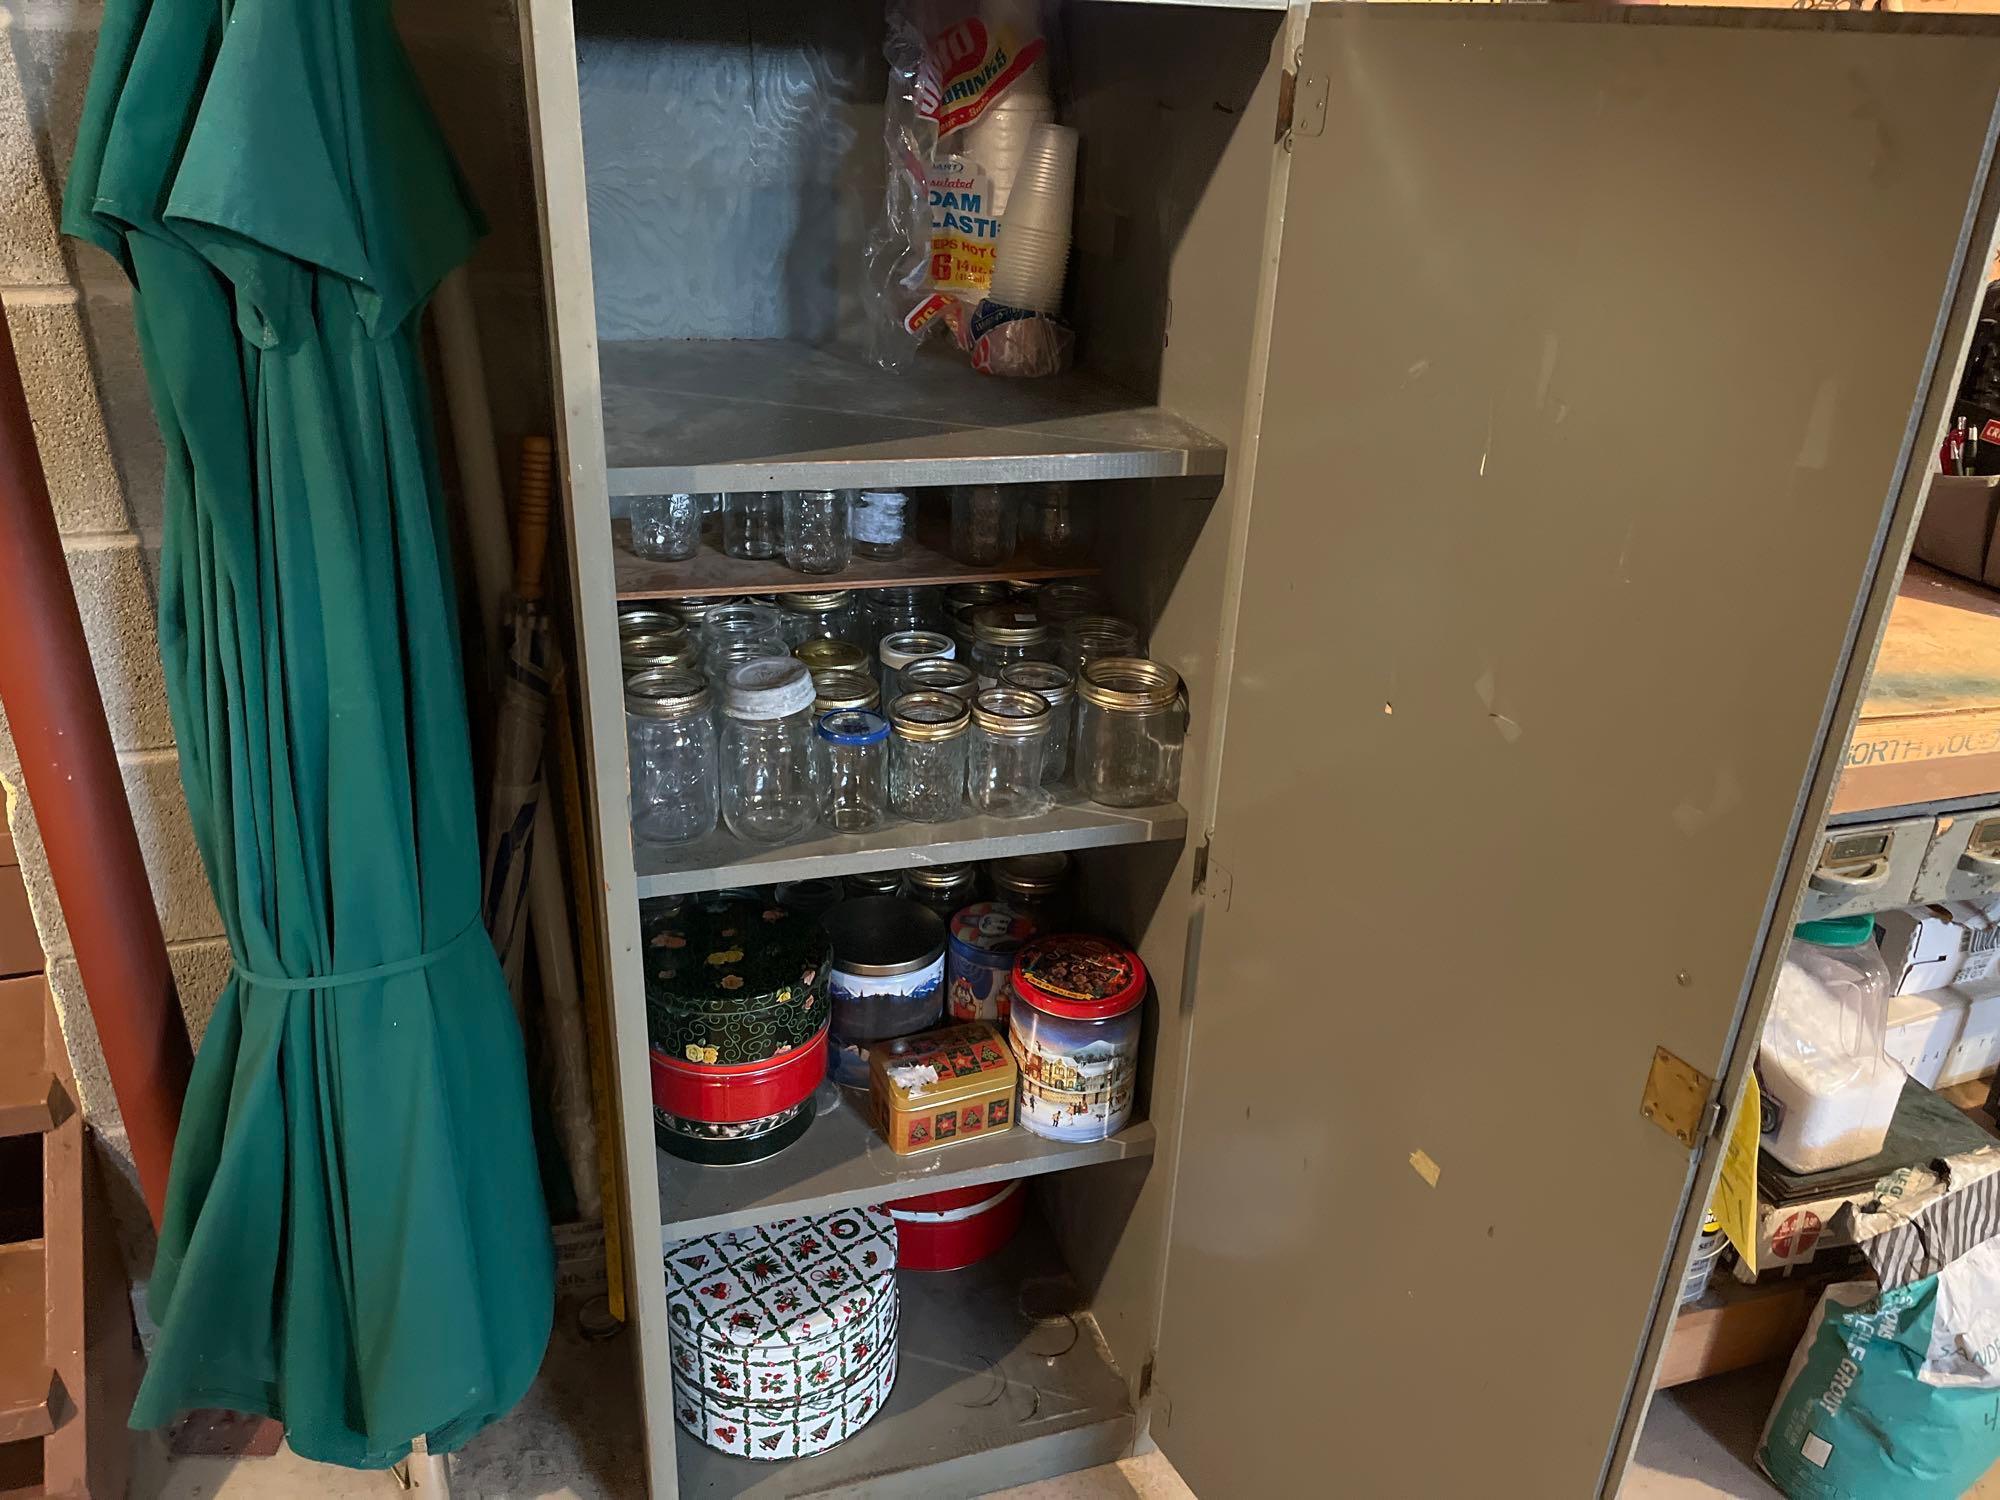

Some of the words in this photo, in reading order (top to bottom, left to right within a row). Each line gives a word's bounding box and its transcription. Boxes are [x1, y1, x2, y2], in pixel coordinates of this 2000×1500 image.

[930, 178, 975, 190] sulated
[962, 242, 987, 258] HOT
[1820, 1358, 1858, 1417] GROUT
